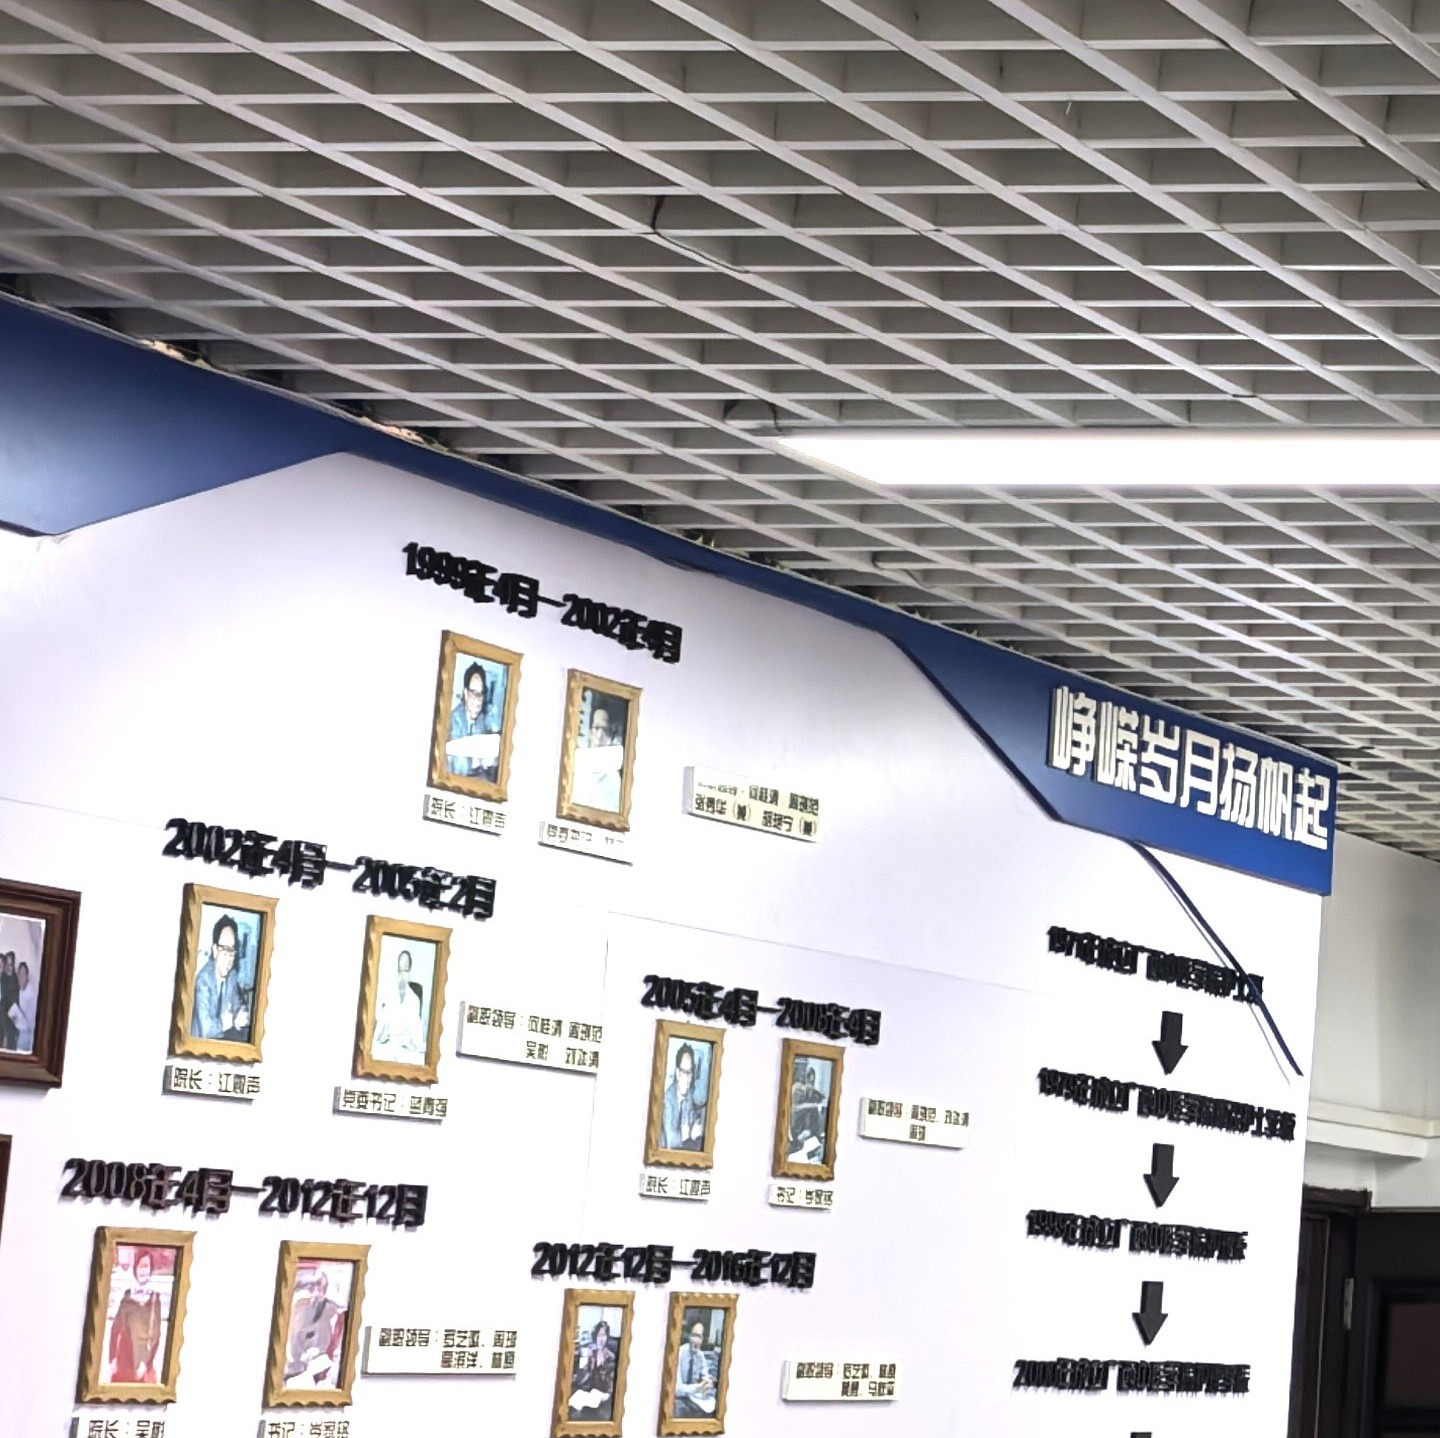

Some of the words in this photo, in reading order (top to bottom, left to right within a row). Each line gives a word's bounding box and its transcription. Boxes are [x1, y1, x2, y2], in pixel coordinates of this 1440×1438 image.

[1048, 686, 1330, 850] 峥嵘岁月扬帆起
